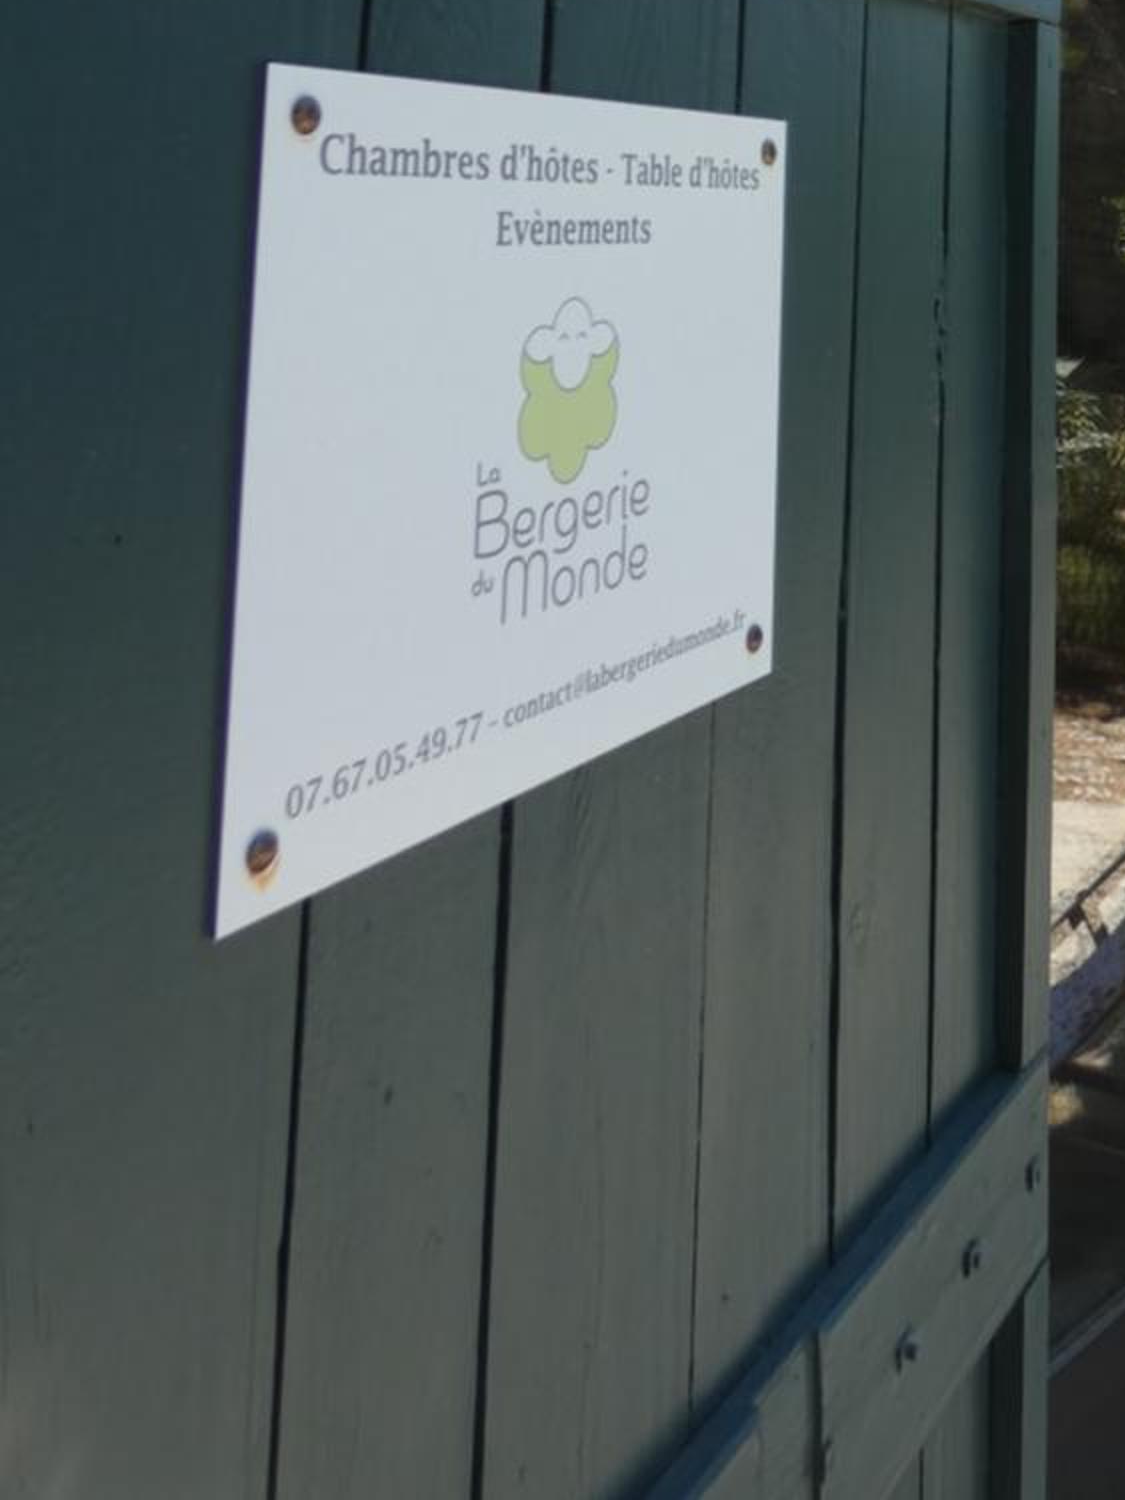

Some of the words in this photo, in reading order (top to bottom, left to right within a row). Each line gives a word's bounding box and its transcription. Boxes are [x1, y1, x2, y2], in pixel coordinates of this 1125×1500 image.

[320, 133, 490, 180] Chambres
[501, 144, 599, 184] d'hôtes
[621, 154, 682, 187] Table
[690, 156, 760, 190] d'hôtes
[496, 209, 651, 246] Evènements
[477, 462, 501, 486] La
[474, 470, 650, 559] Bergerie
[471, 570, 494, 597] du
[501, 524, 648, 625] Monde
[285, 711, 483, 819] 07.67.05.49.77
